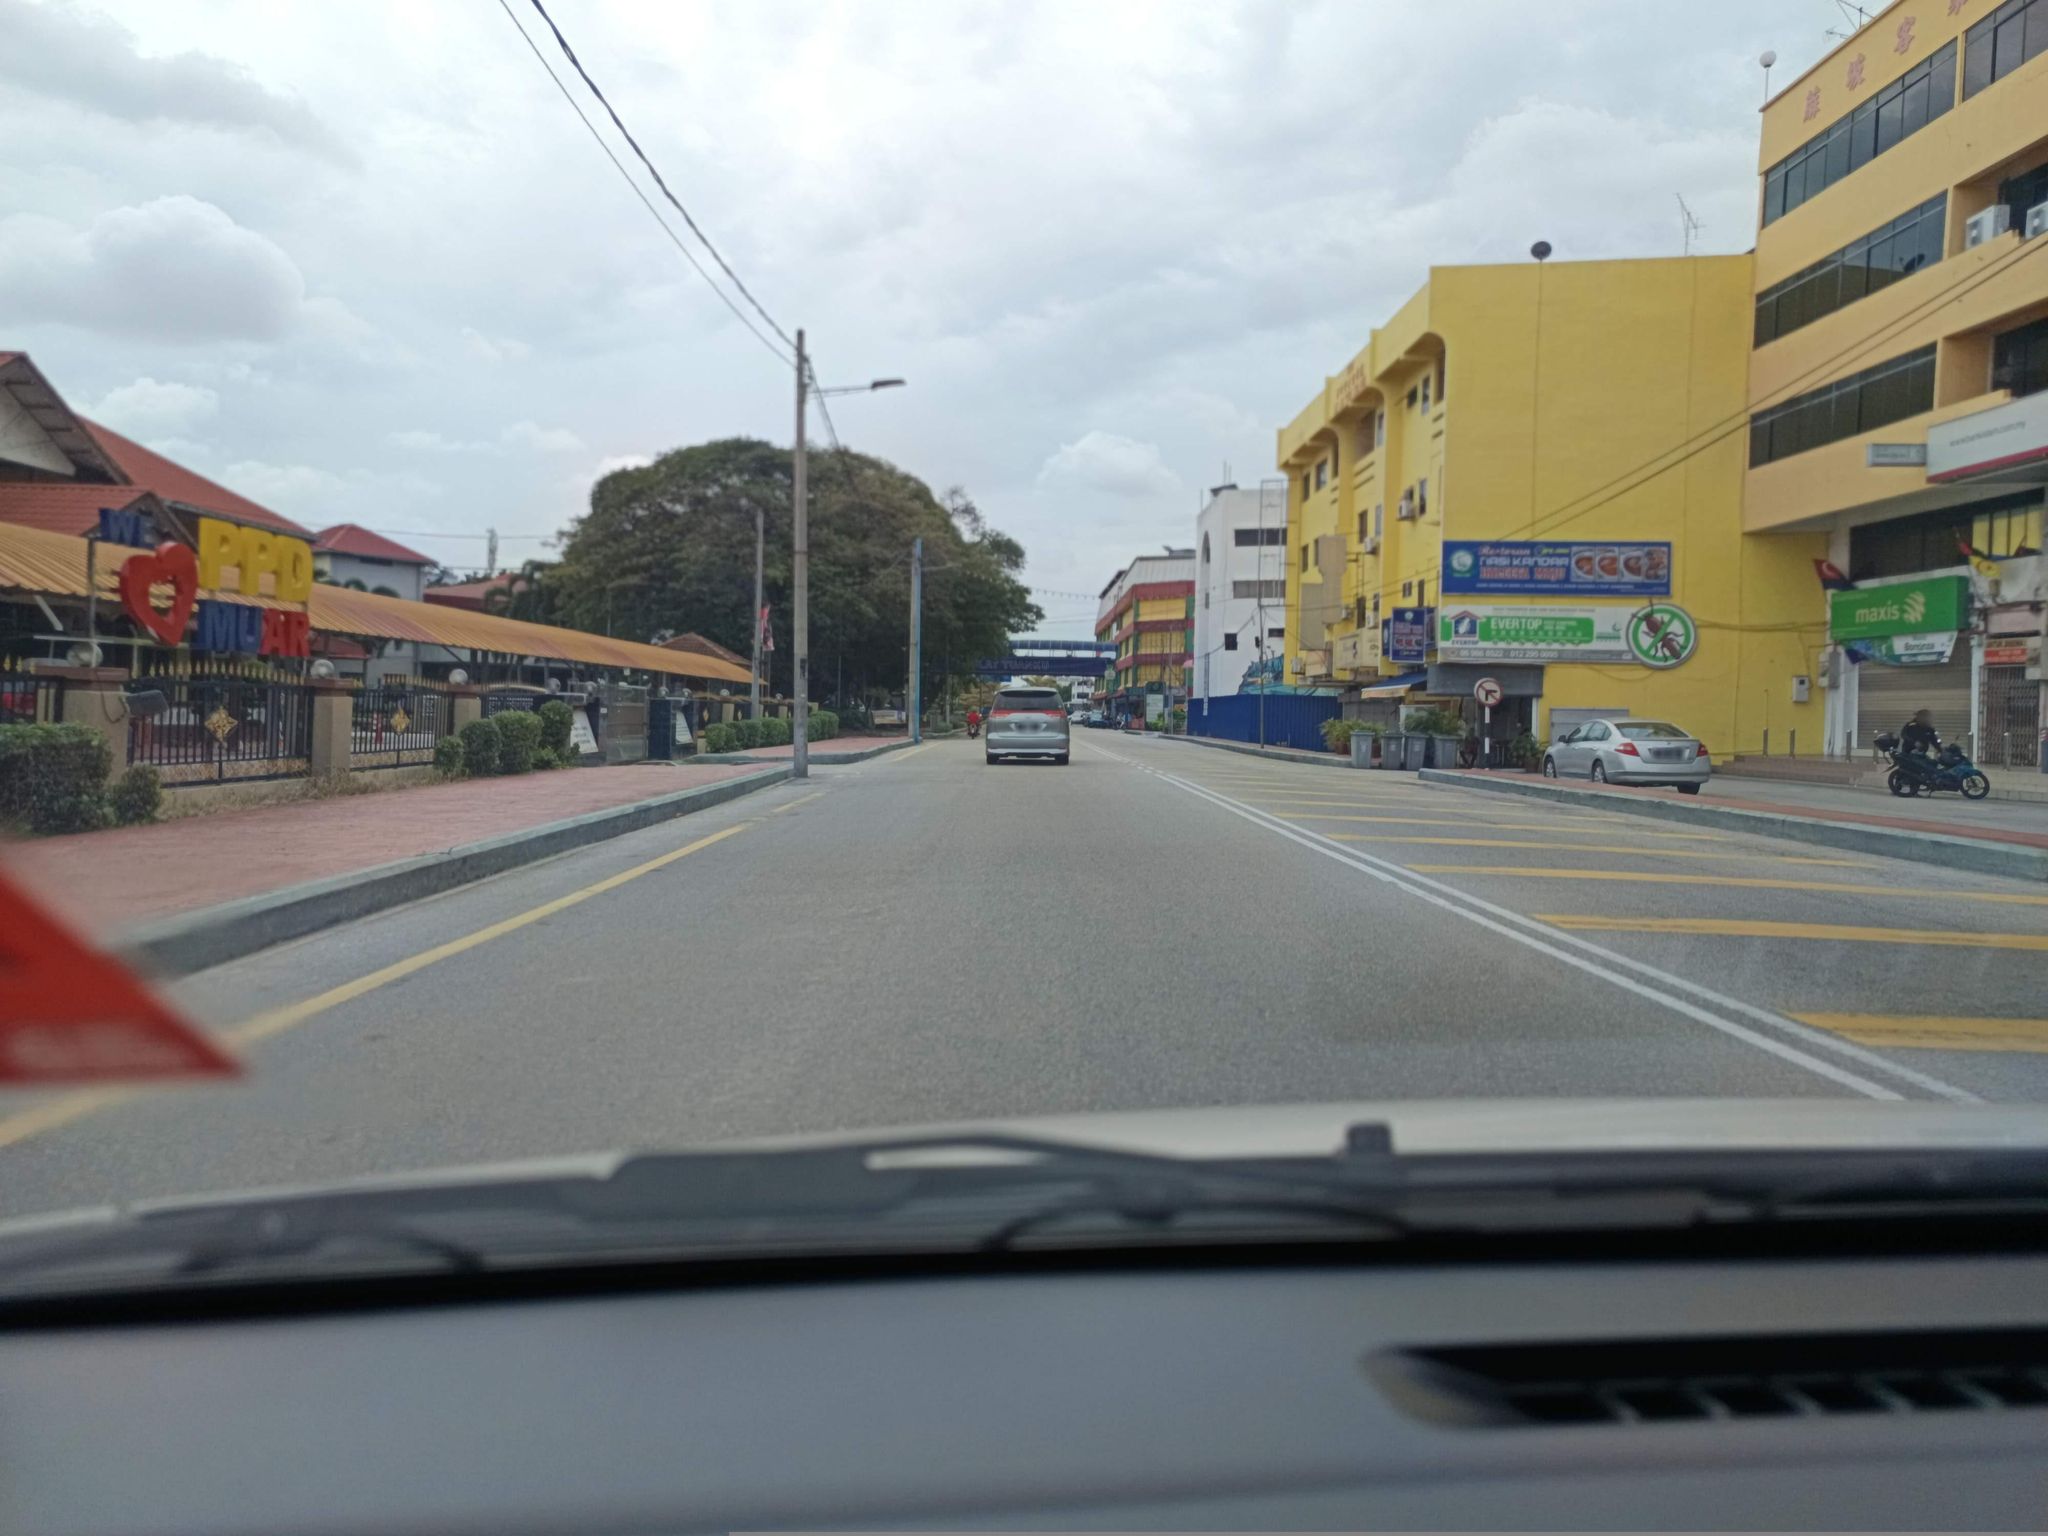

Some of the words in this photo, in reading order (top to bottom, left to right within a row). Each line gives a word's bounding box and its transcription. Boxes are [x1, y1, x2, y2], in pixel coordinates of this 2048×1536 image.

[98, 508, 155, 549] WE
[198, 517, 313, 604] PPD
[192, 600, 311, 658] MUAR
[1490, 617, 1542, 630] EVERTOP
[1855, 600, 1900, 624] maxis
